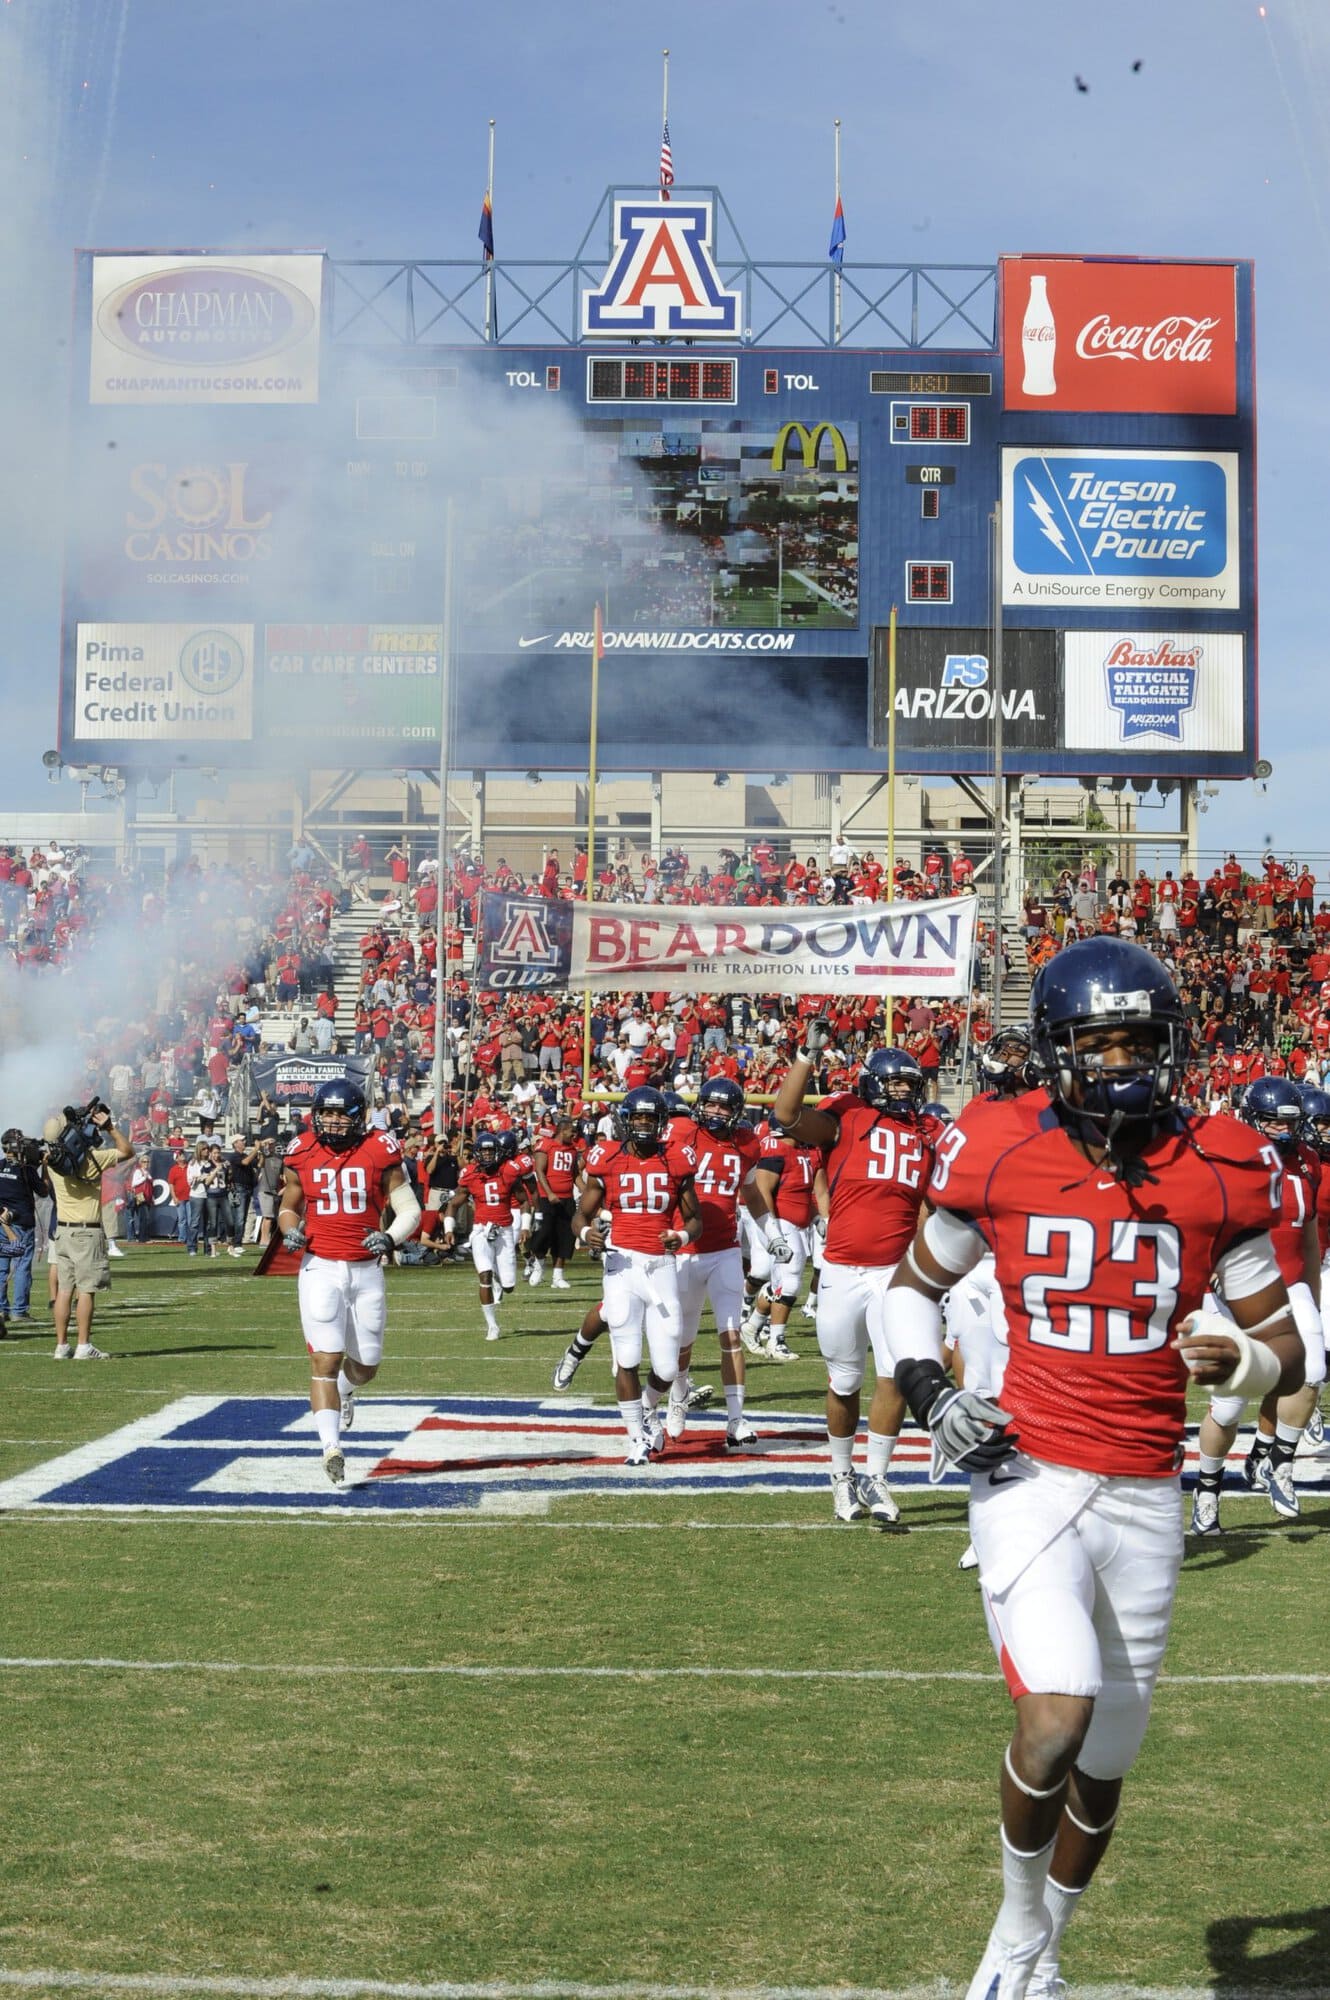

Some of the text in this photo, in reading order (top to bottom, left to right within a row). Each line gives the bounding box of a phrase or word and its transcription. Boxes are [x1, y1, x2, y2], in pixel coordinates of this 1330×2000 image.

[582, 201, 741, 336] A
[135, 291, 274, 326] CHAPMAN
[1076, 314, 1220, 361] Coca-Cola
[106, 377, 302, 391] CHAPMANTUCSON.COM
[506, 372, 541, 387] TOL
[784, 375, 819, 390] TOL
[911, 375, 948, 393] WSU
[920, 468, 941, 483] QTR
[126, 462, 272, 529] SOL
[1068, 472, 1176, 502] Tucson
[1079, 502, 1206, 531] Electric
[125, 534, 271, 561] CASINOS
[1092, 531, 1205, 560] Power
[146, 573, 249, 584] SOLCASINOS.COM
[1013, 583, 1226, 600] A UniSource Energy Company
[86, 642, 144, 661] Pima
[1108, 641, 1199, 667] Bashas'
[270, 655, 438, 674] CAR CARE CENTERS
[941, 654, 989, 687] FS
[85, 672, 173, 691] Federal
[1114, 672, 1189, 684] OFFICIAL
[1114, 685, 1189, 696] TAILGATE
[885, 688, 1036, 720] ARIZONA
[1114, 697, 1188, 705] HEADQUARTERS
[84, 702, 235, 722] Credit Union
[1127, 714, 1177, 724] ARIZONA
[490, 901, 558, 966] A
[692, 963, 849, 975] THE TRADITION LIVES
[318, 1066, 345, 1074] FAMILY
[276, 1082, 315, 1096] Family
[553, 1151, 573, 1171] 69
[867, 1127, 923, 1189] 92
[694, 1152, 741, 1196] 43
[312, 1167, 367, 1215] 38
[484, 1182, 500, 1206] 6
[619, 1172, 670, 1214] 26
[1021, 1214, 1182, 1356] 23
